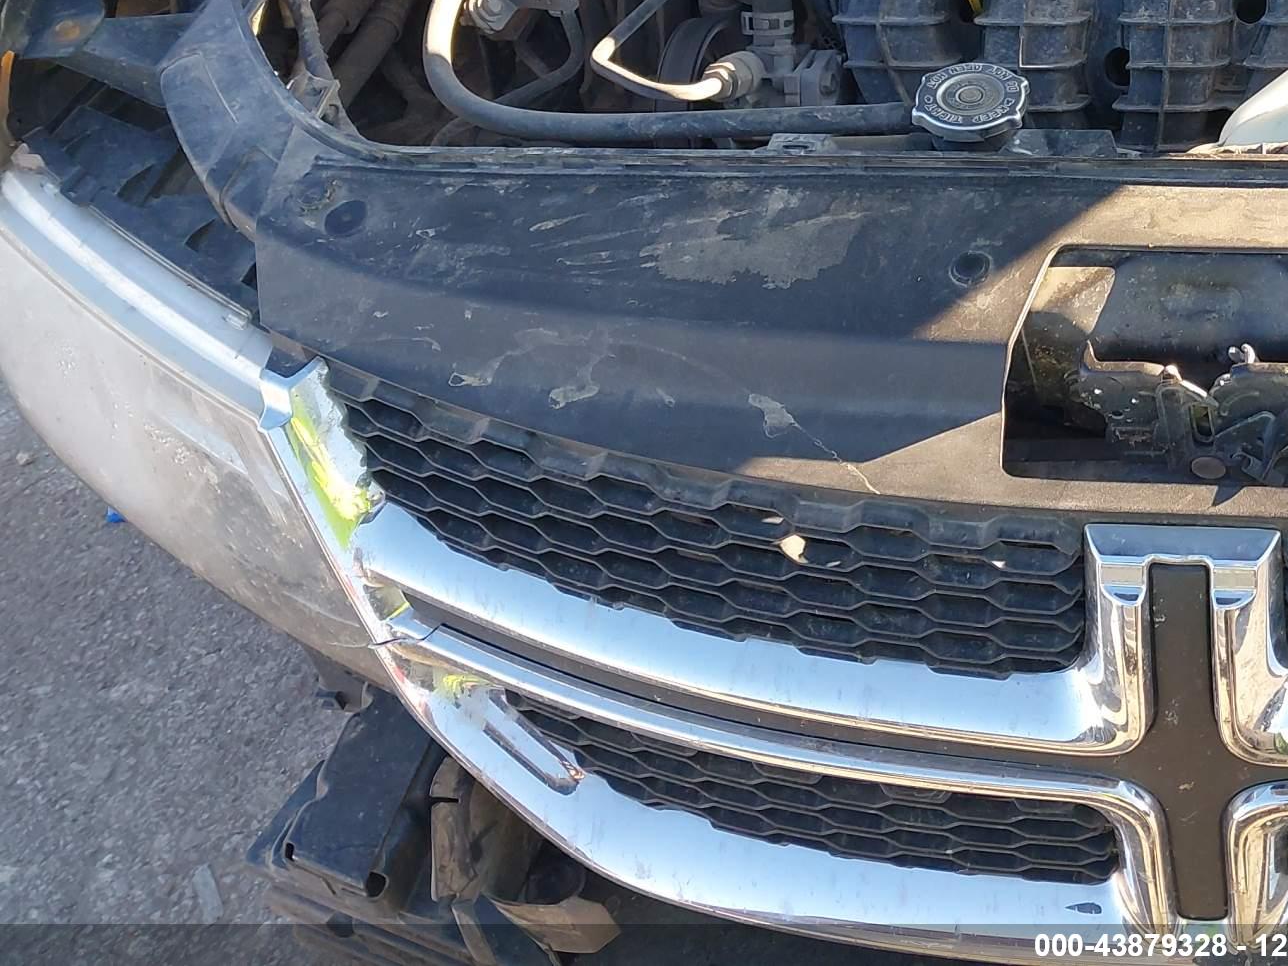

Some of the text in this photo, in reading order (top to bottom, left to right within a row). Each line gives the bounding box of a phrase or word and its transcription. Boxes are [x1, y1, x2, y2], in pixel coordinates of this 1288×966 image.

[949, 65, 982, 75] OPEN
[924, 104, 1010, 124] KEEP TIGHT
